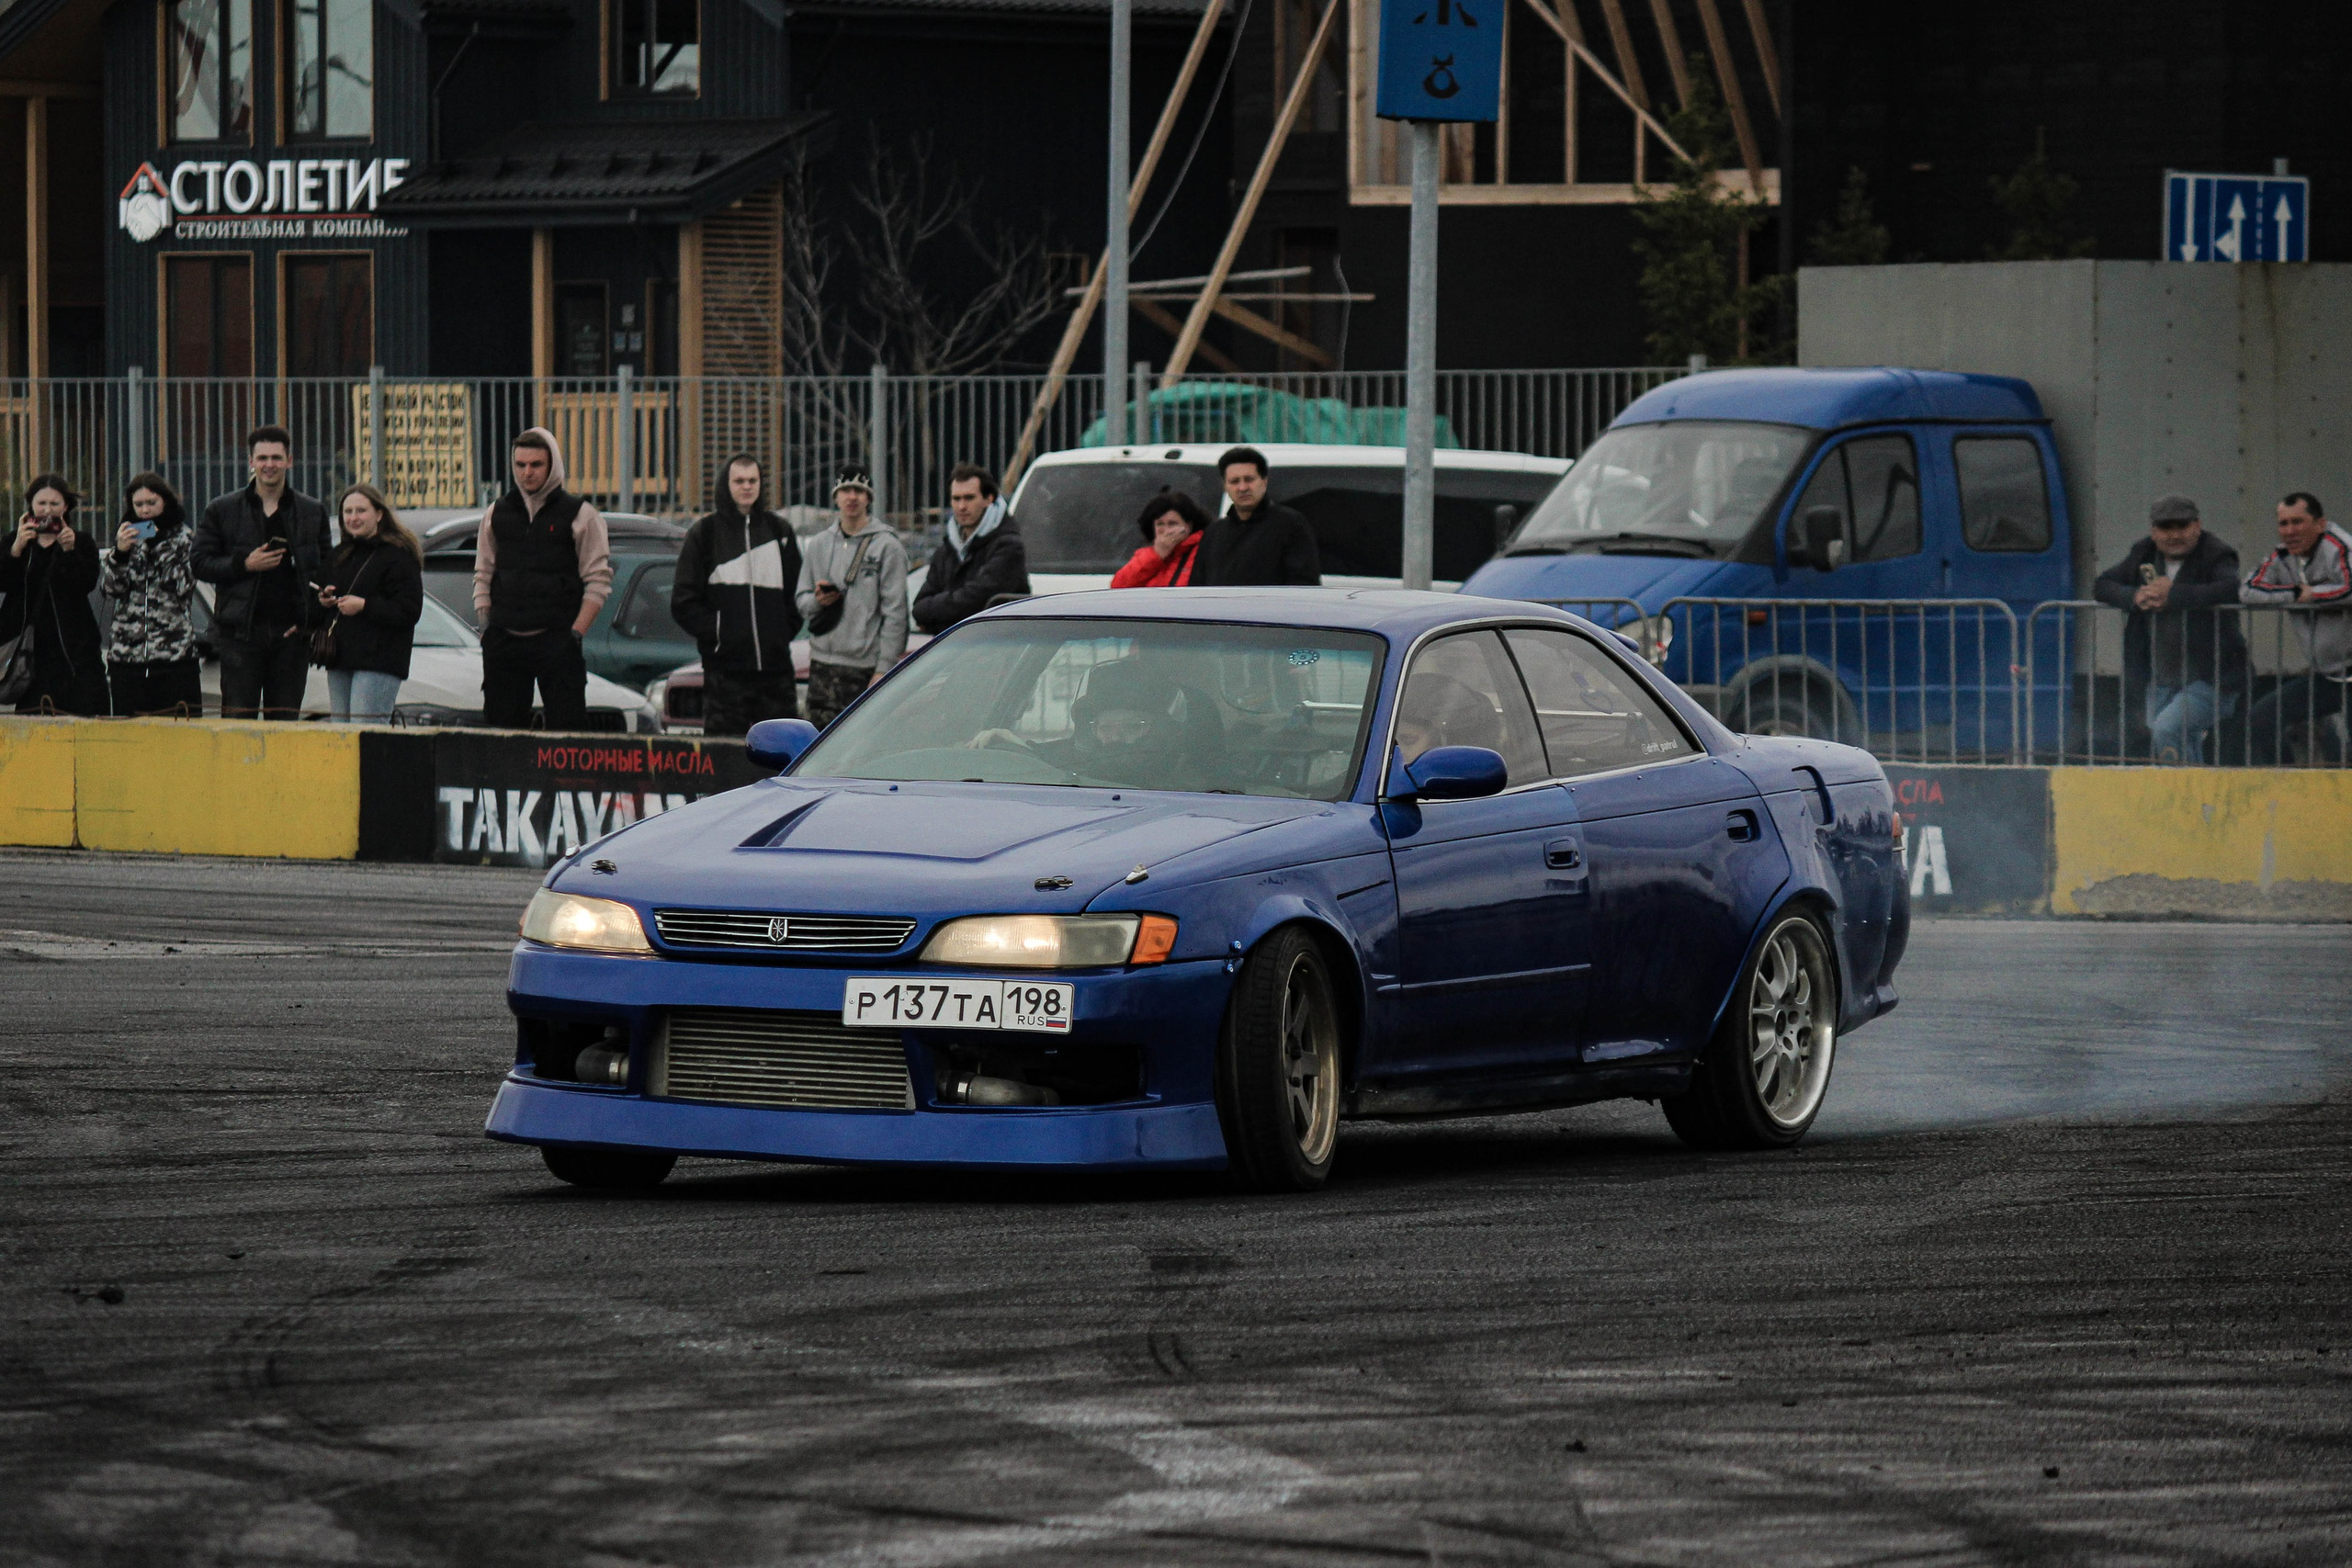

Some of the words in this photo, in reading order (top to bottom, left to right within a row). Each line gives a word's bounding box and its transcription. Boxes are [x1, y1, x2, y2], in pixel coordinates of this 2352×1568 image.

[175, 220, 306, 240] СТРОИТЕЛЬНАЯ
[537, 747, 642, 773] МОТОРНЫЕ
[649, 750, 715, 775] МАСЛА
[1892, 779, 1945, 806] СЛА
[439, 786, 710, 856] TAKAYA
[1007, 986, 1062, 1016] 198
[1017, 1015, 1045, 1026] RUS
